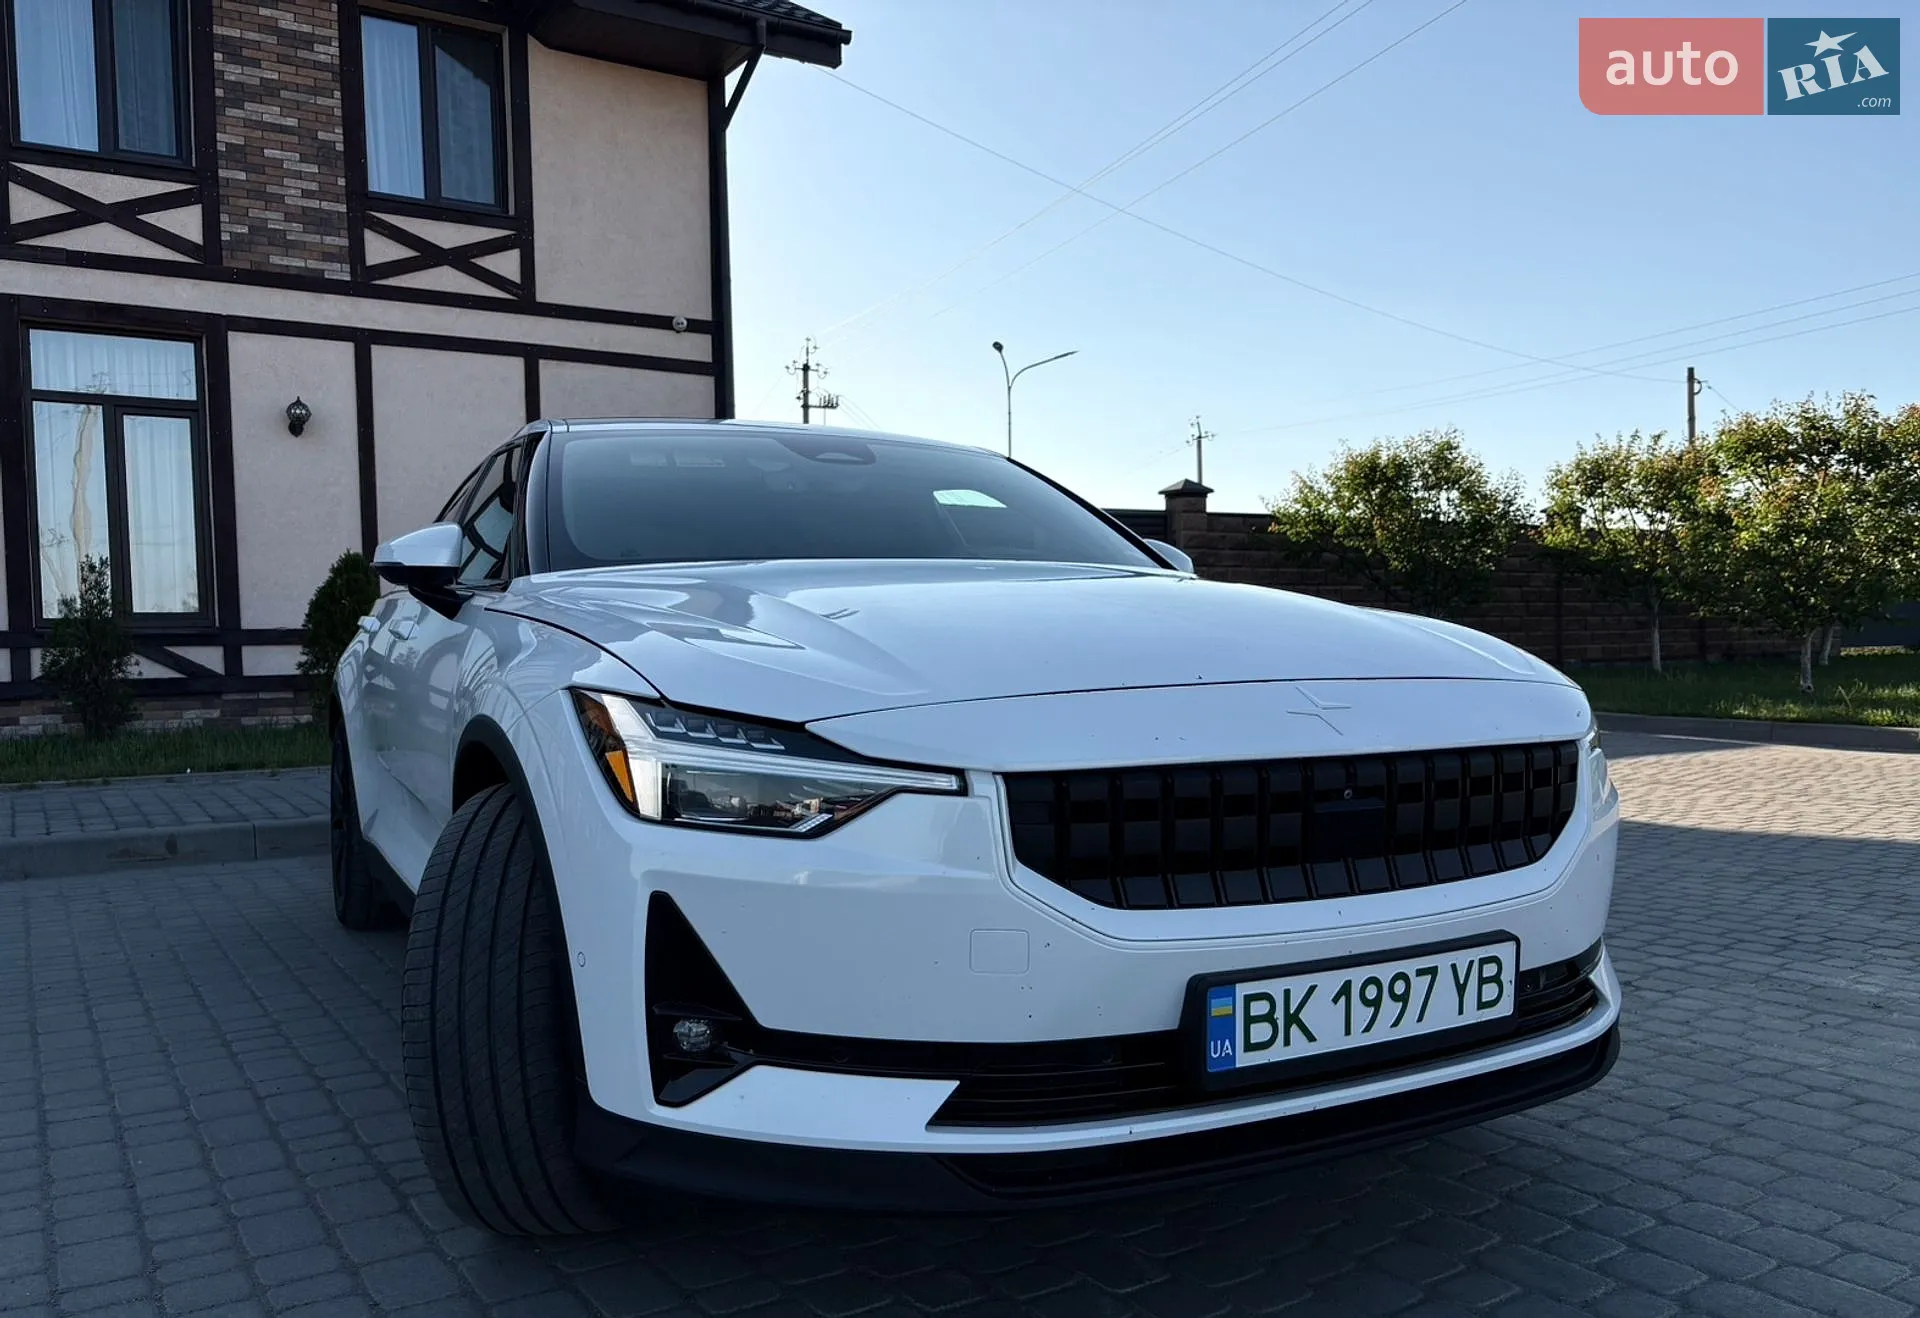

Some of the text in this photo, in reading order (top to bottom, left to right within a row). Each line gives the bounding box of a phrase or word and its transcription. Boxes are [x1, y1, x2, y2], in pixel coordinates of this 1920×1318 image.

[1242, 954, 1504, 1053] BK 1997 YB
[1210, 1039, 1233, 1058] UA
